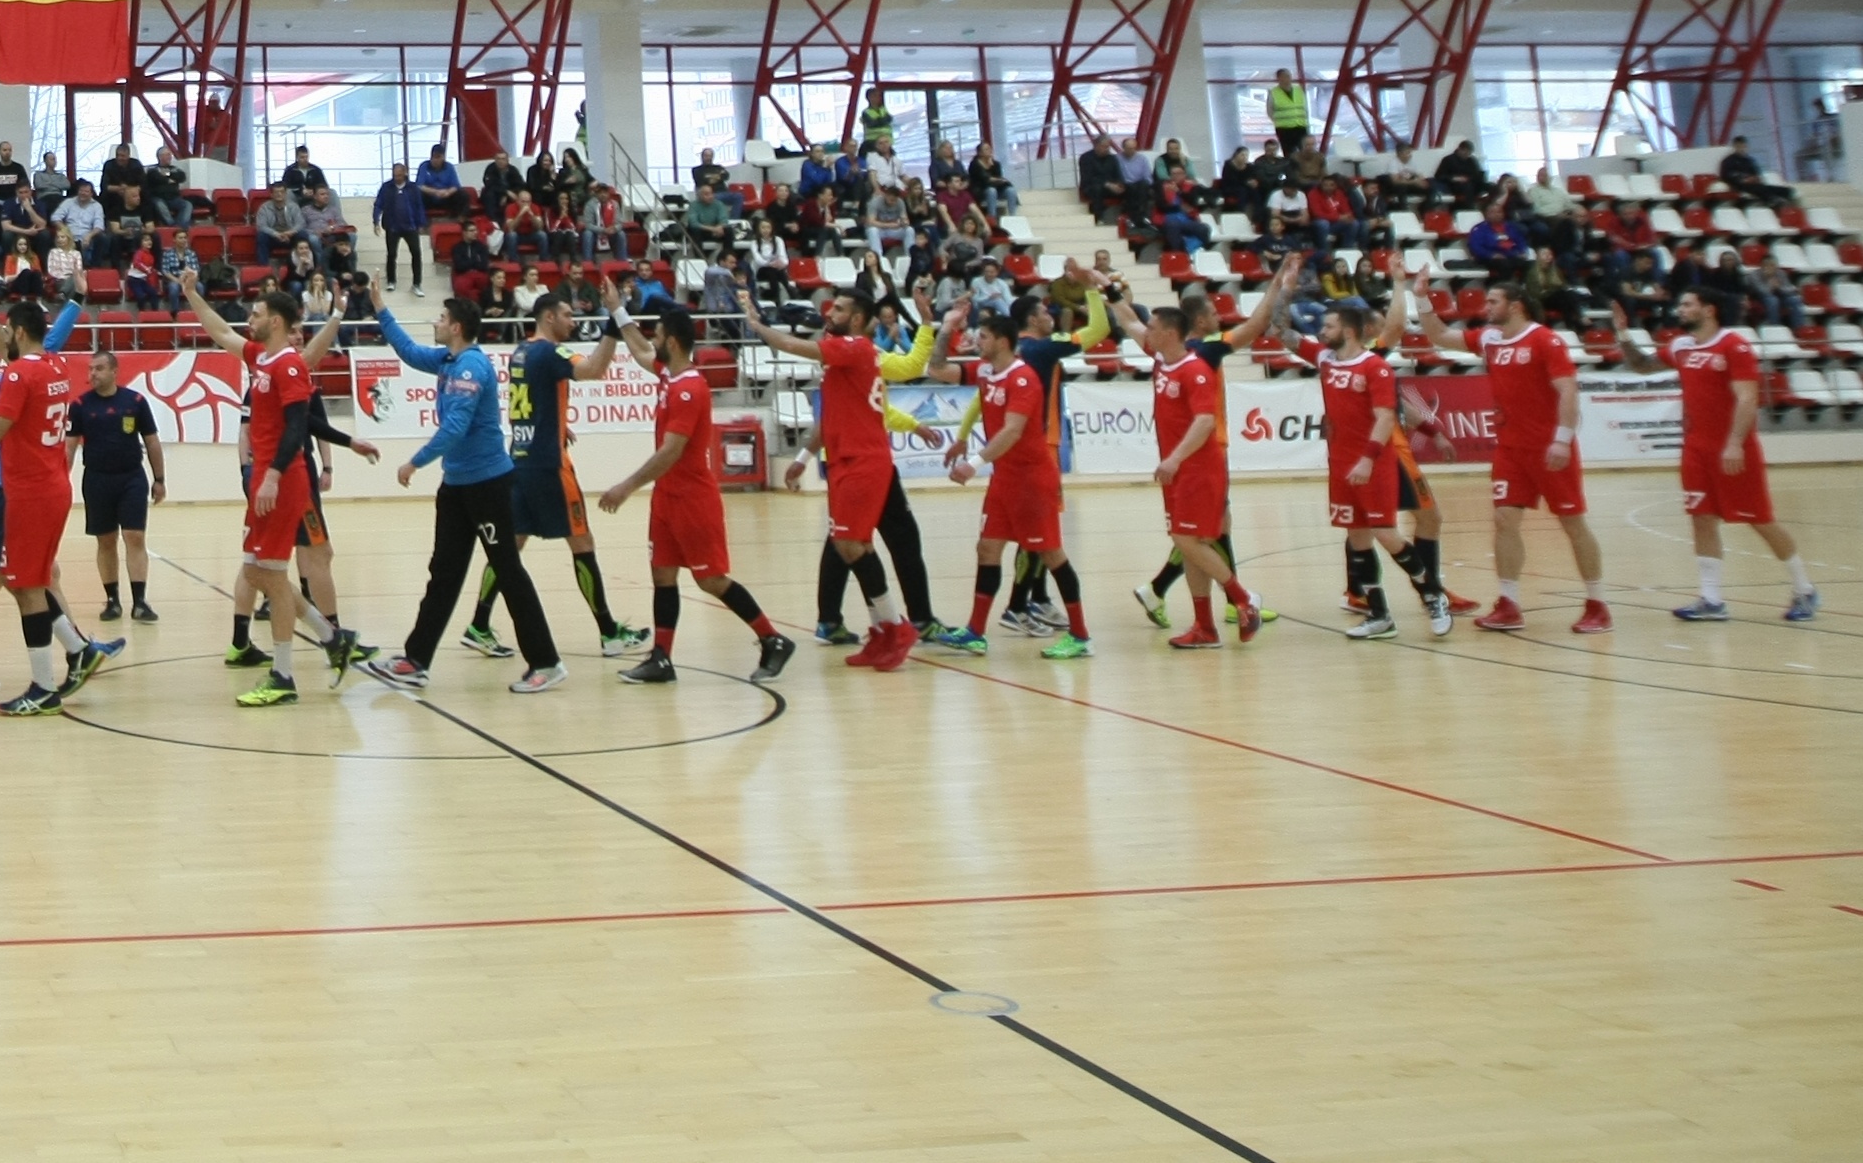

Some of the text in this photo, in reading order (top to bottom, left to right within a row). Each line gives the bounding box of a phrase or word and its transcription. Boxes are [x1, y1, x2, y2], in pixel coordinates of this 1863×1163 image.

[1327, 368, 1351, 388] 73
[510, 383, 533, 419] 24
[1331, 504, 1354, 524] 73
